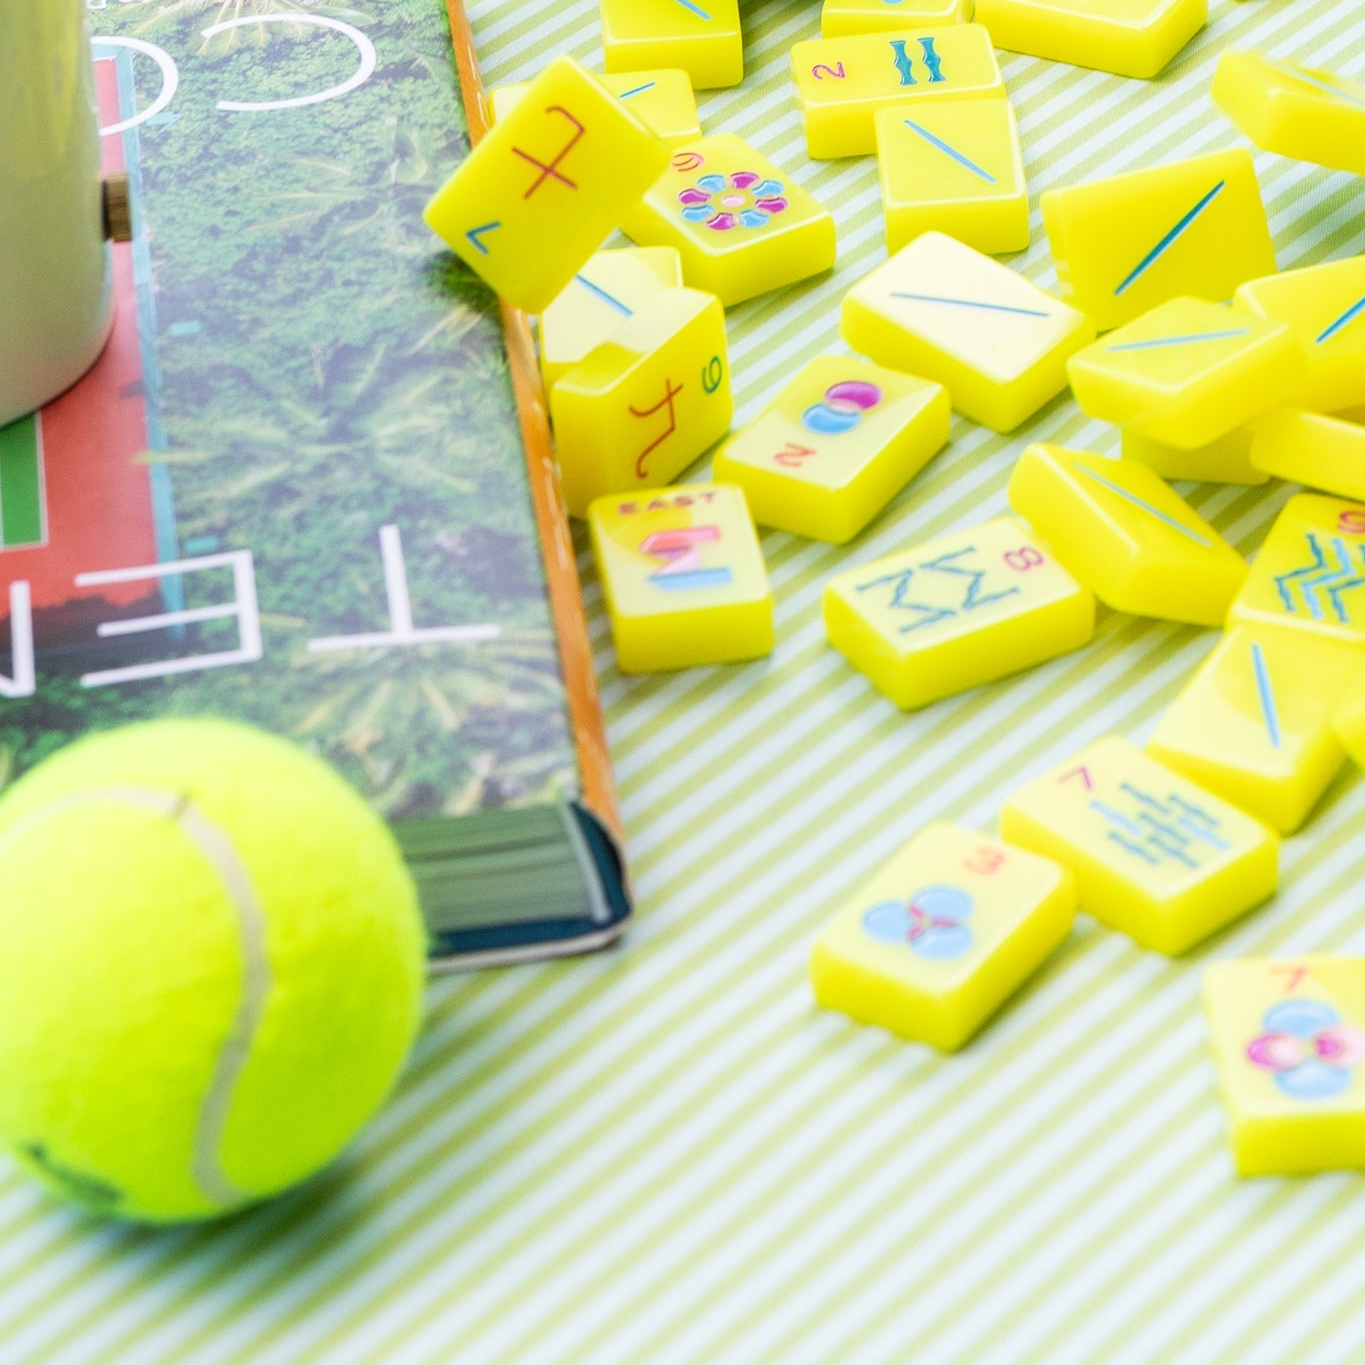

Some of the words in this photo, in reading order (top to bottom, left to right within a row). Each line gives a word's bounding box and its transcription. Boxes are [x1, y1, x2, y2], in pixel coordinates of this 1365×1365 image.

[811, 60, 846, 81] 2
[773, 441, 817, 468] 2
[618, 490, 717, 516] EAST
[1003, 546, 1045, 572] 8
[1056, 765, 1094, 792] 7
[1268, 964, 1310, 995] 7
